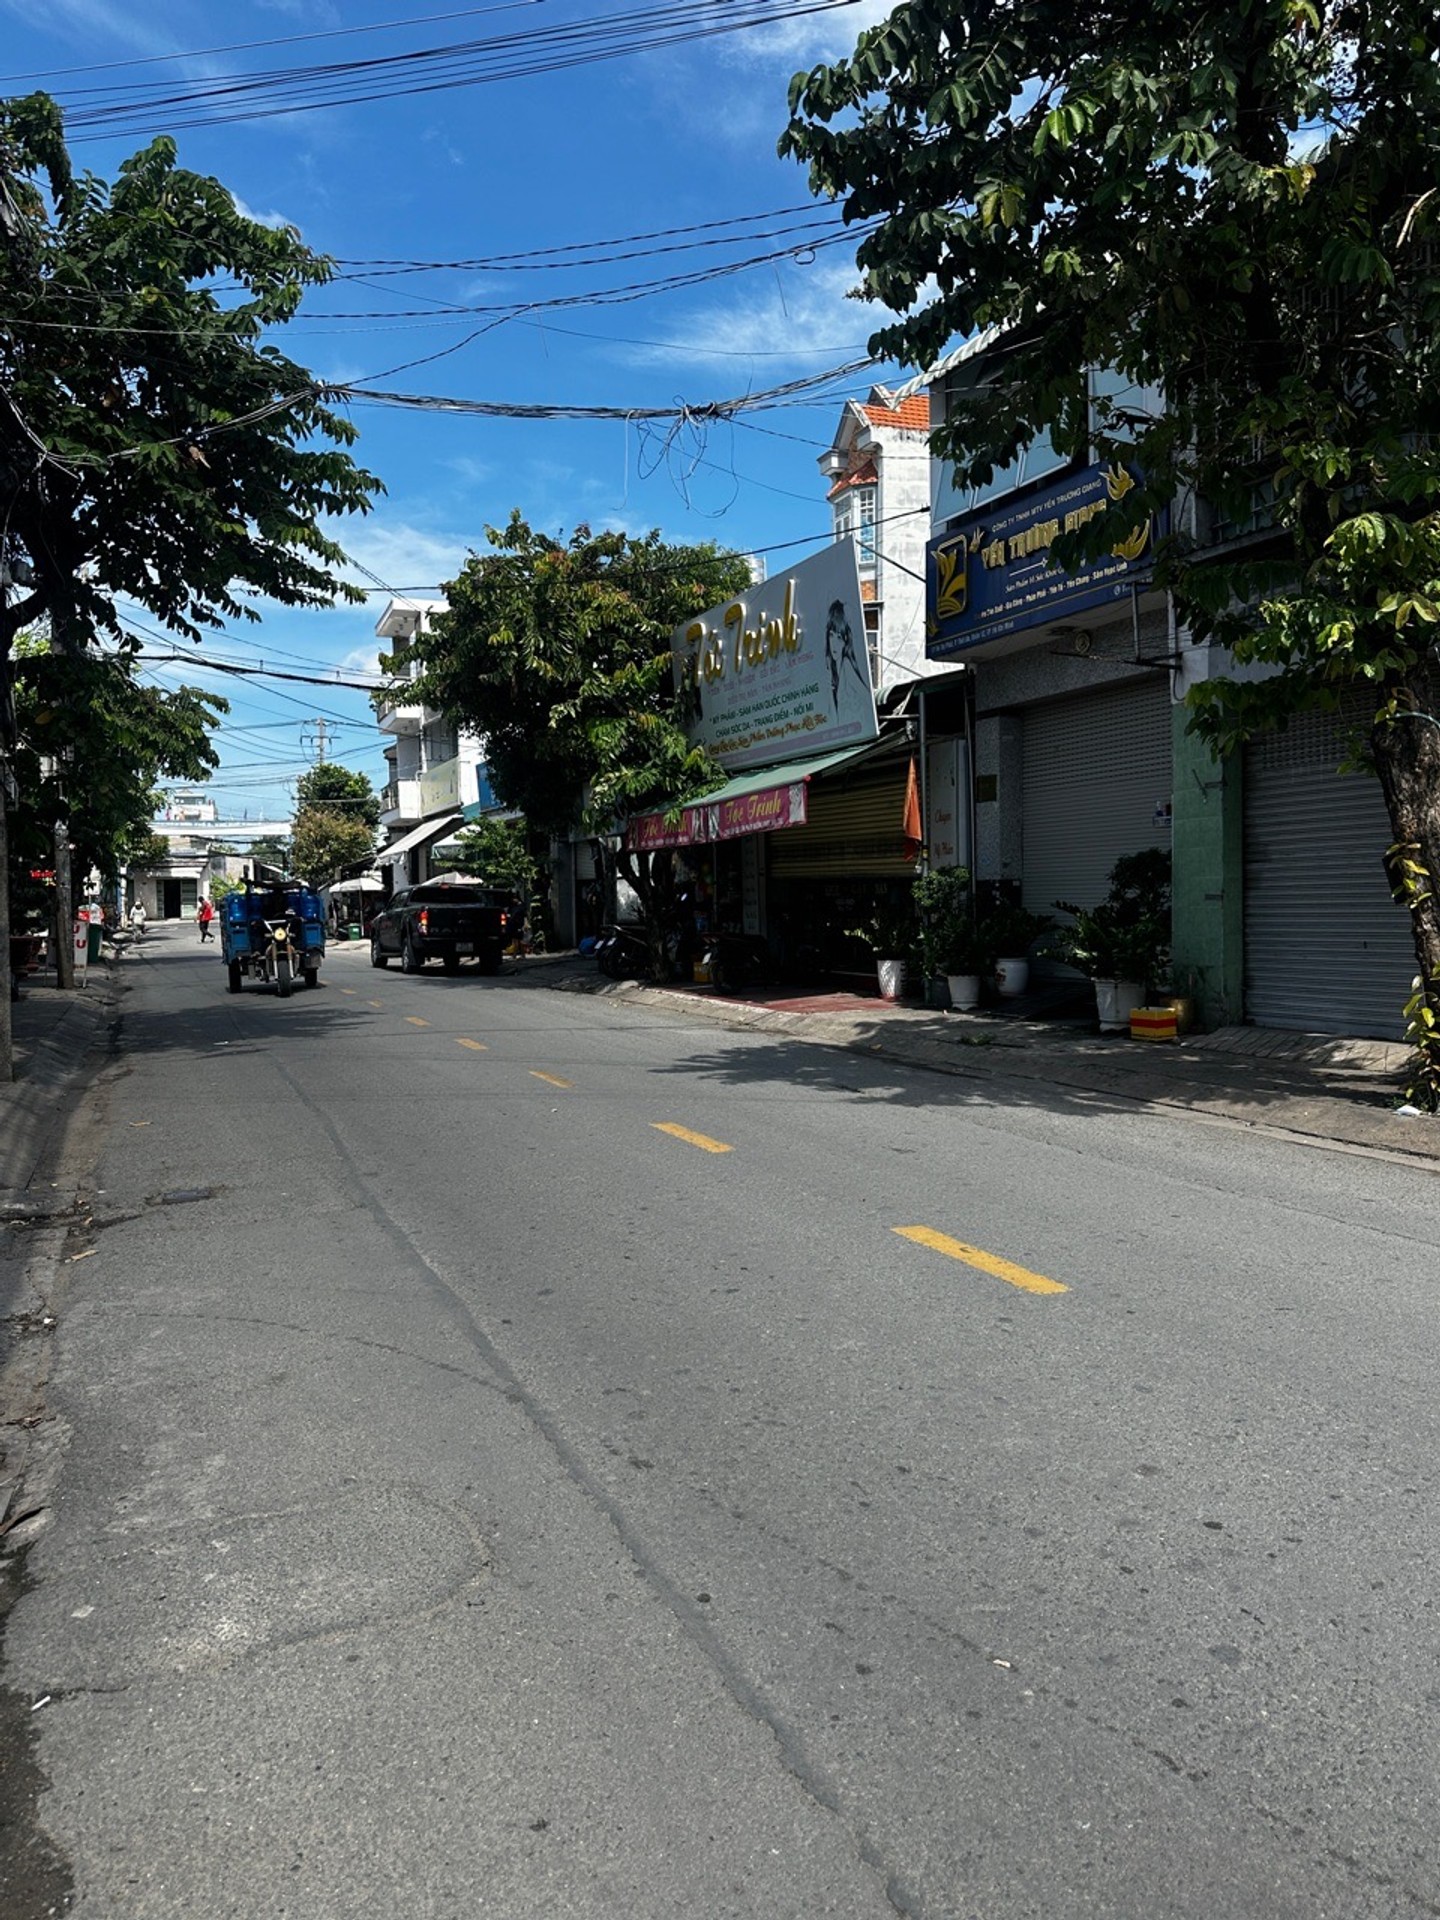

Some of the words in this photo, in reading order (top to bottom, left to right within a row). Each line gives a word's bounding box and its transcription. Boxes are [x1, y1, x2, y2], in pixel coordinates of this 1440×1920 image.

[992, 520, 1008, 533] CÔNG
[1015, 510, 1030, 523] TNHH
[1031, 505, 1043, 517] MTV
[1043, 498, 1056, 510] YẾN
[1081, 478, 1102, 494] GIANG
[981, 538, 1006, 569] YẾN
[1008, 518, 1059, 560] TRƯỜNG
[724, 579, 802, 674] Trinh
[753, 714, 774, 728] TRANG
[747, 790, 782, 820] Trinh
